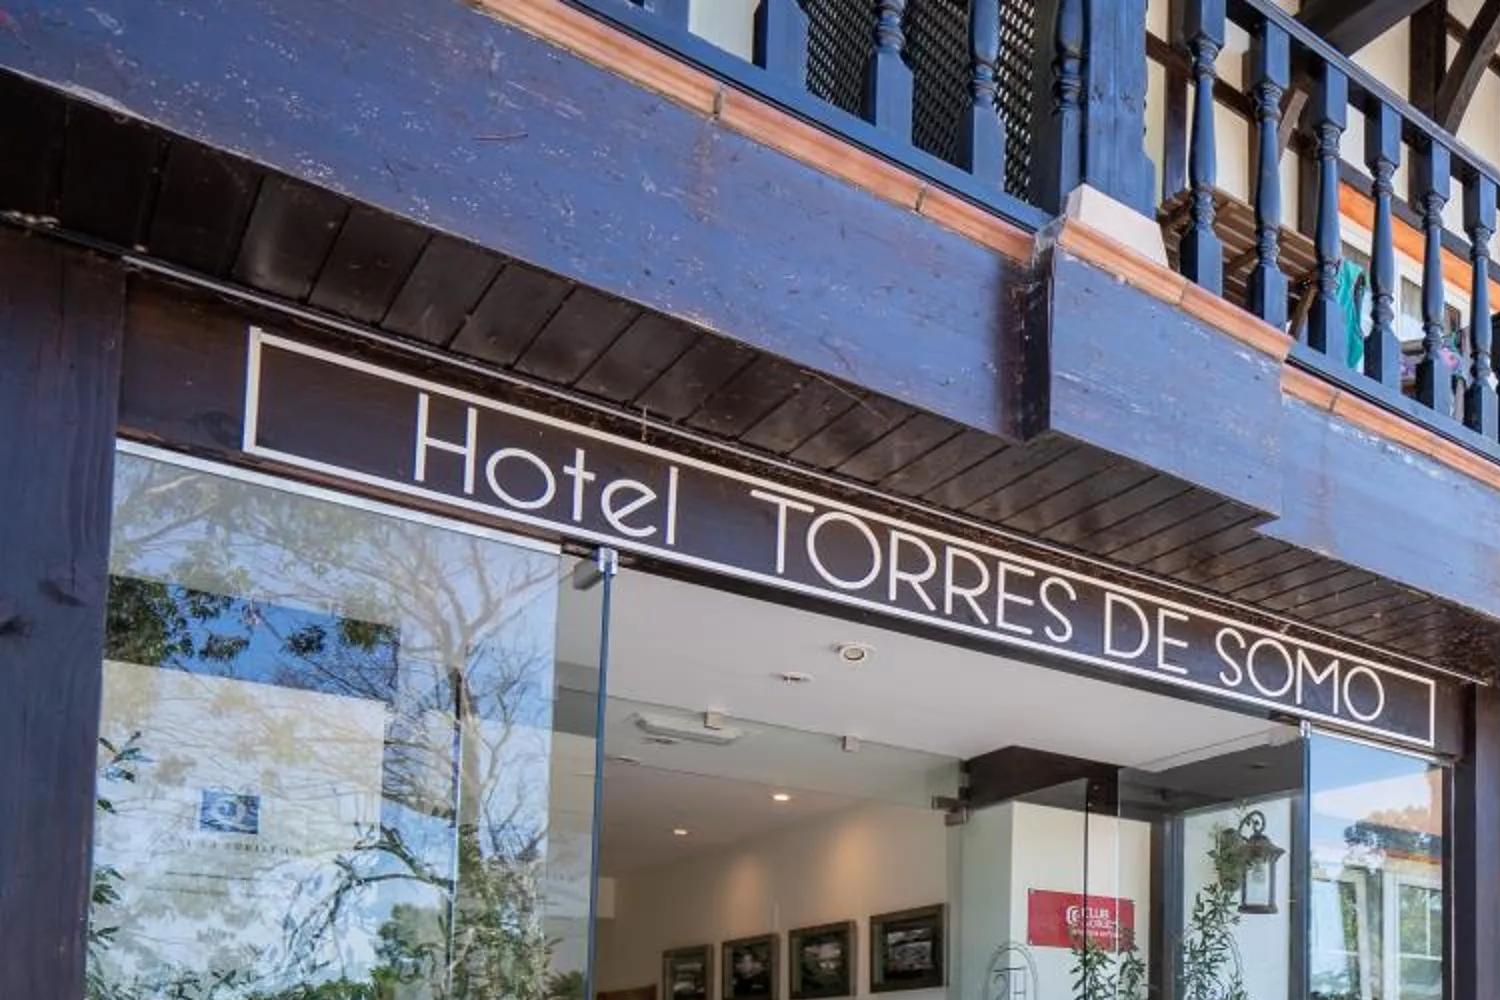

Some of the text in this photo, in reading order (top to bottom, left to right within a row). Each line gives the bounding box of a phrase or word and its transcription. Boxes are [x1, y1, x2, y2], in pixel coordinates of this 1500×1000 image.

[414, 391, 1385, 722] Hotel TORRES DE SOMO
